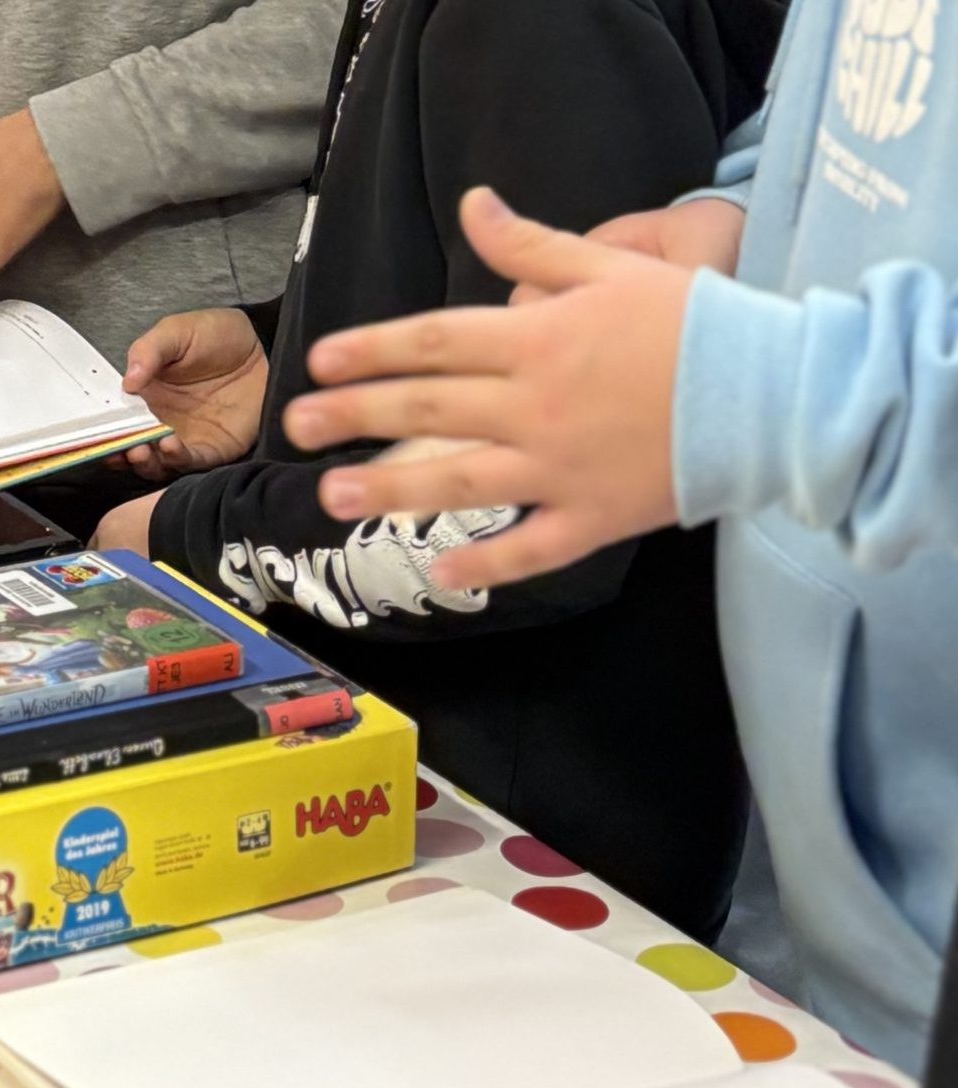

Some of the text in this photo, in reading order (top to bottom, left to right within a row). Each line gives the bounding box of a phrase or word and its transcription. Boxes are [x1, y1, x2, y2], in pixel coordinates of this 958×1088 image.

[20, 684, 106, 719] WUNDERLAND
[63, 827, 119, 849] Kinderspiel
[75, 900, 111, 922] 2019
